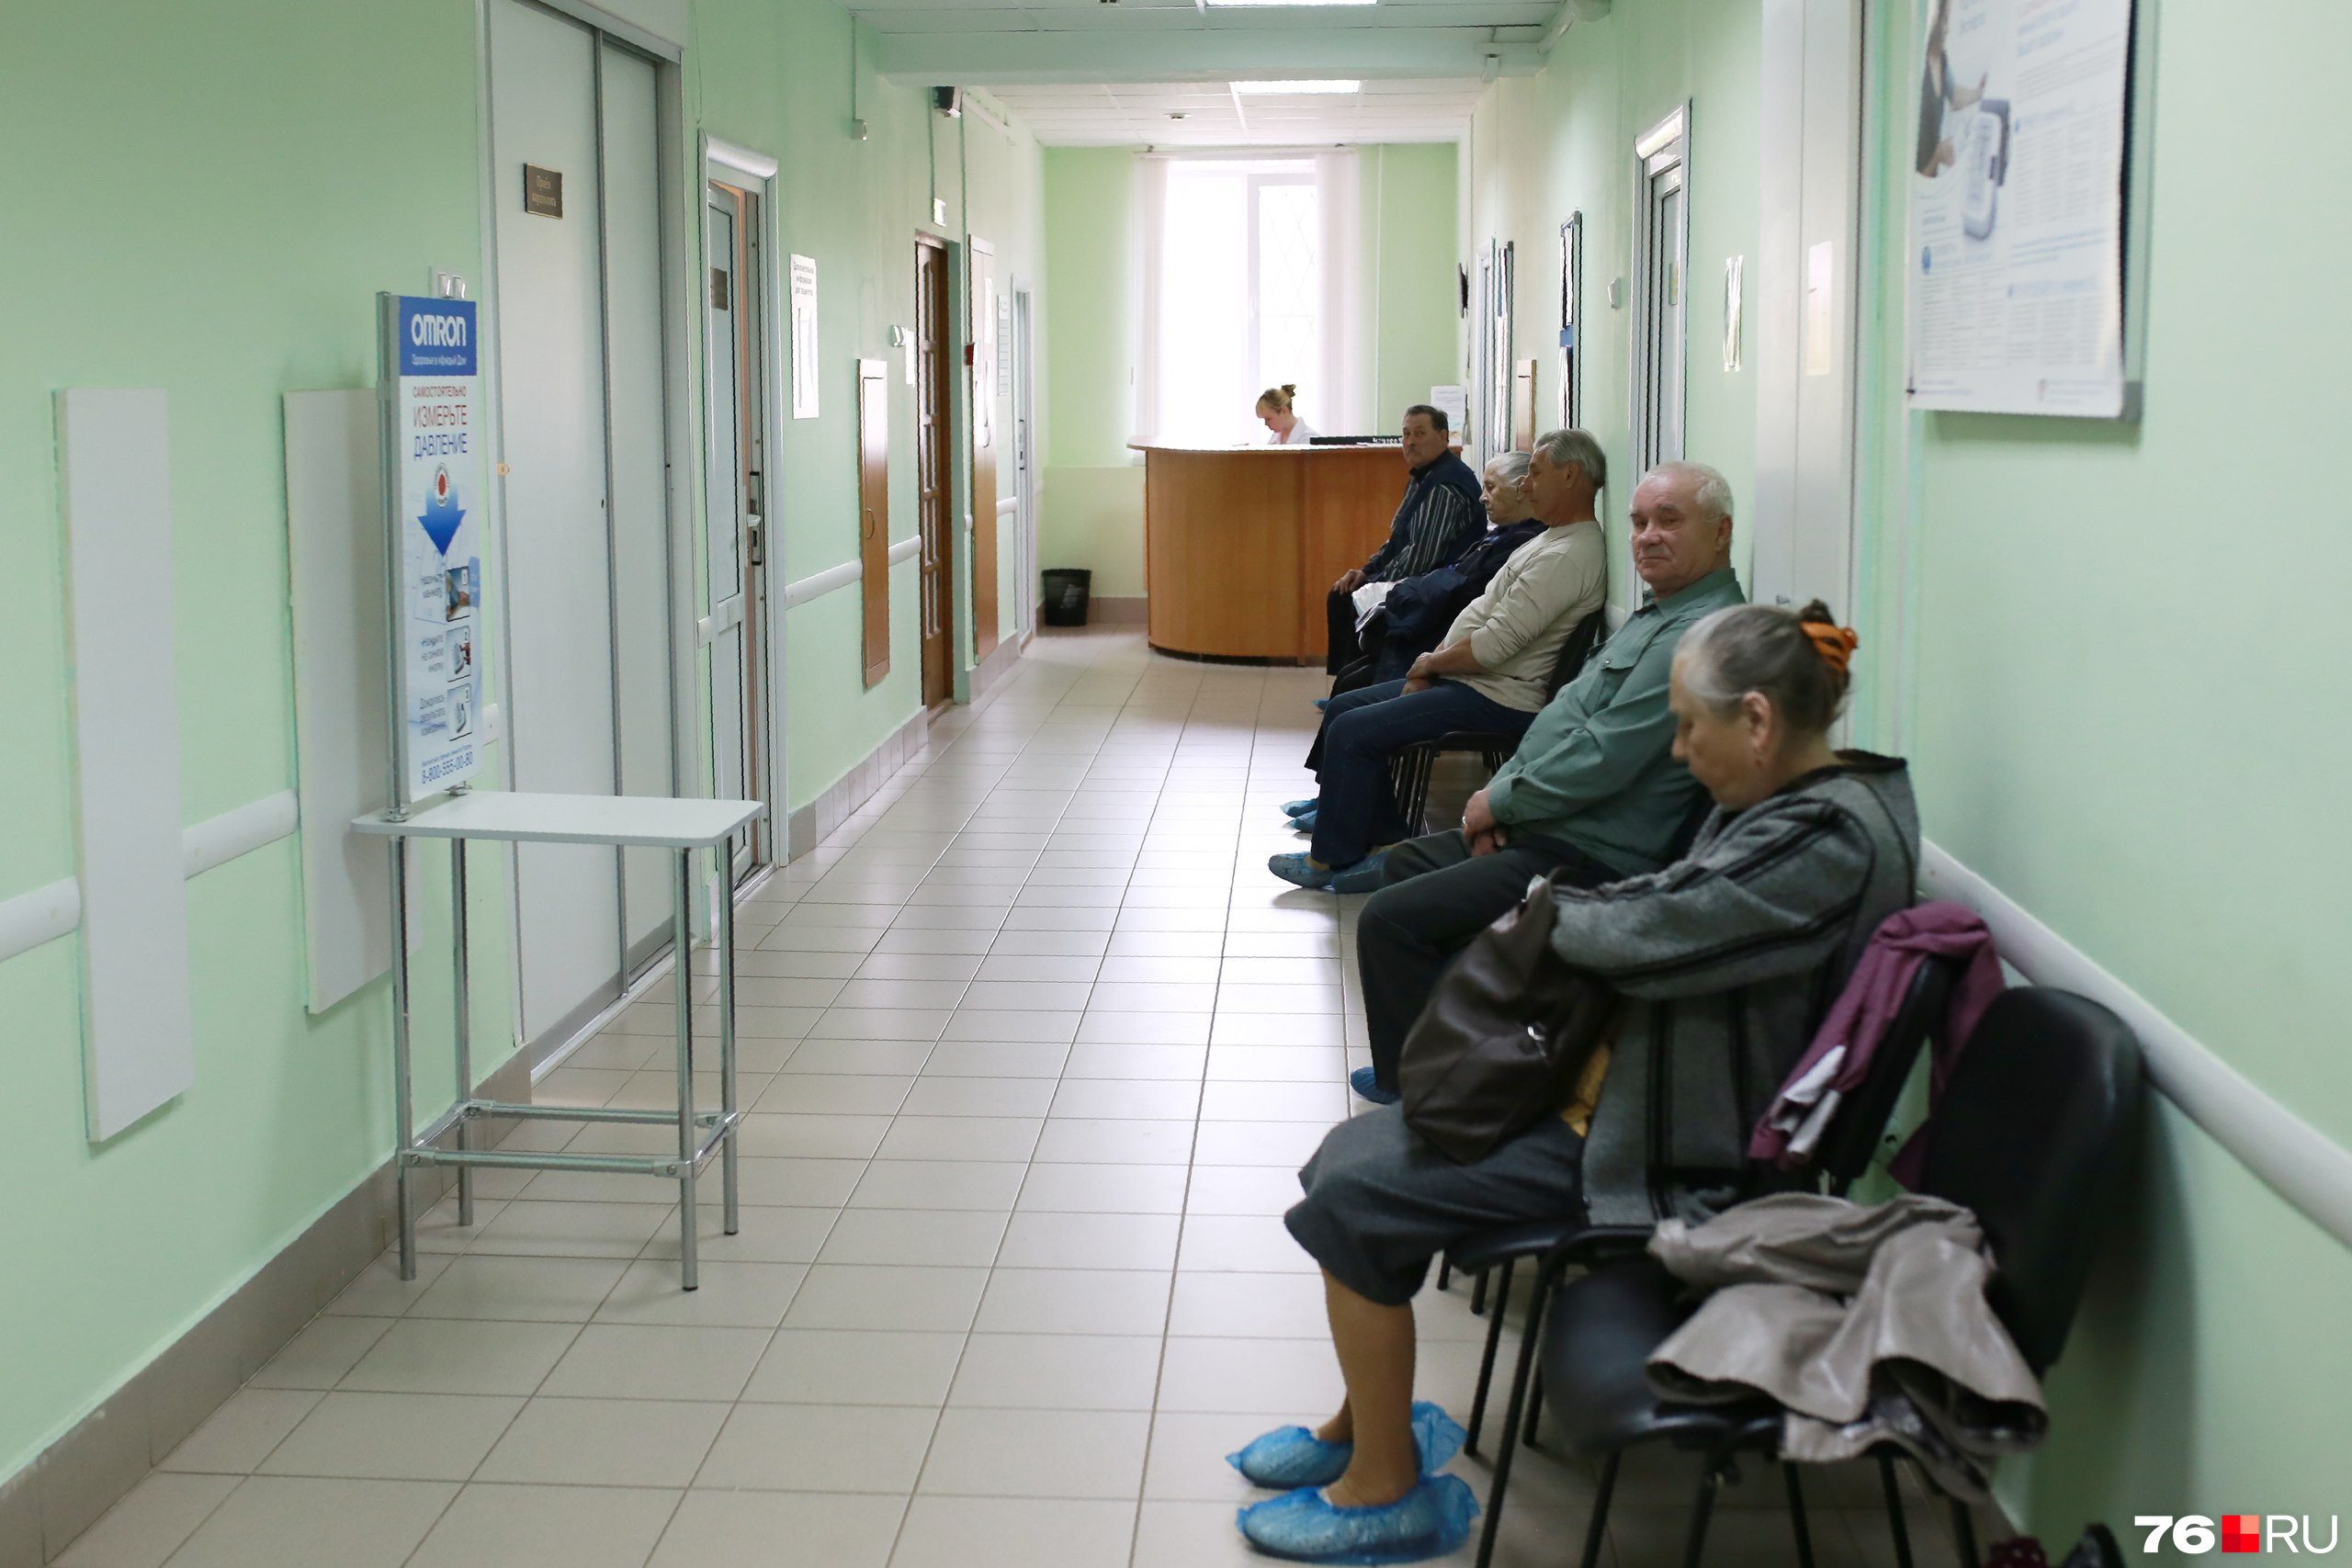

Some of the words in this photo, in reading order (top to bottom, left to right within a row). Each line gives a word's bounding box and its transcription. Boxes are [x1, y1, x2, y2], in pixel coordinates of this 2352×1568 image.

[413, 386, 467, 397] САМОСТОЯТЕЛЬНО
[413, 405, 467, 427] ИЗМЕРЬТЕ
[413, 433, 468, 461] ДАВЛЕНИЕ
[422, 751, 472, 784] 8-800-555-00-80
